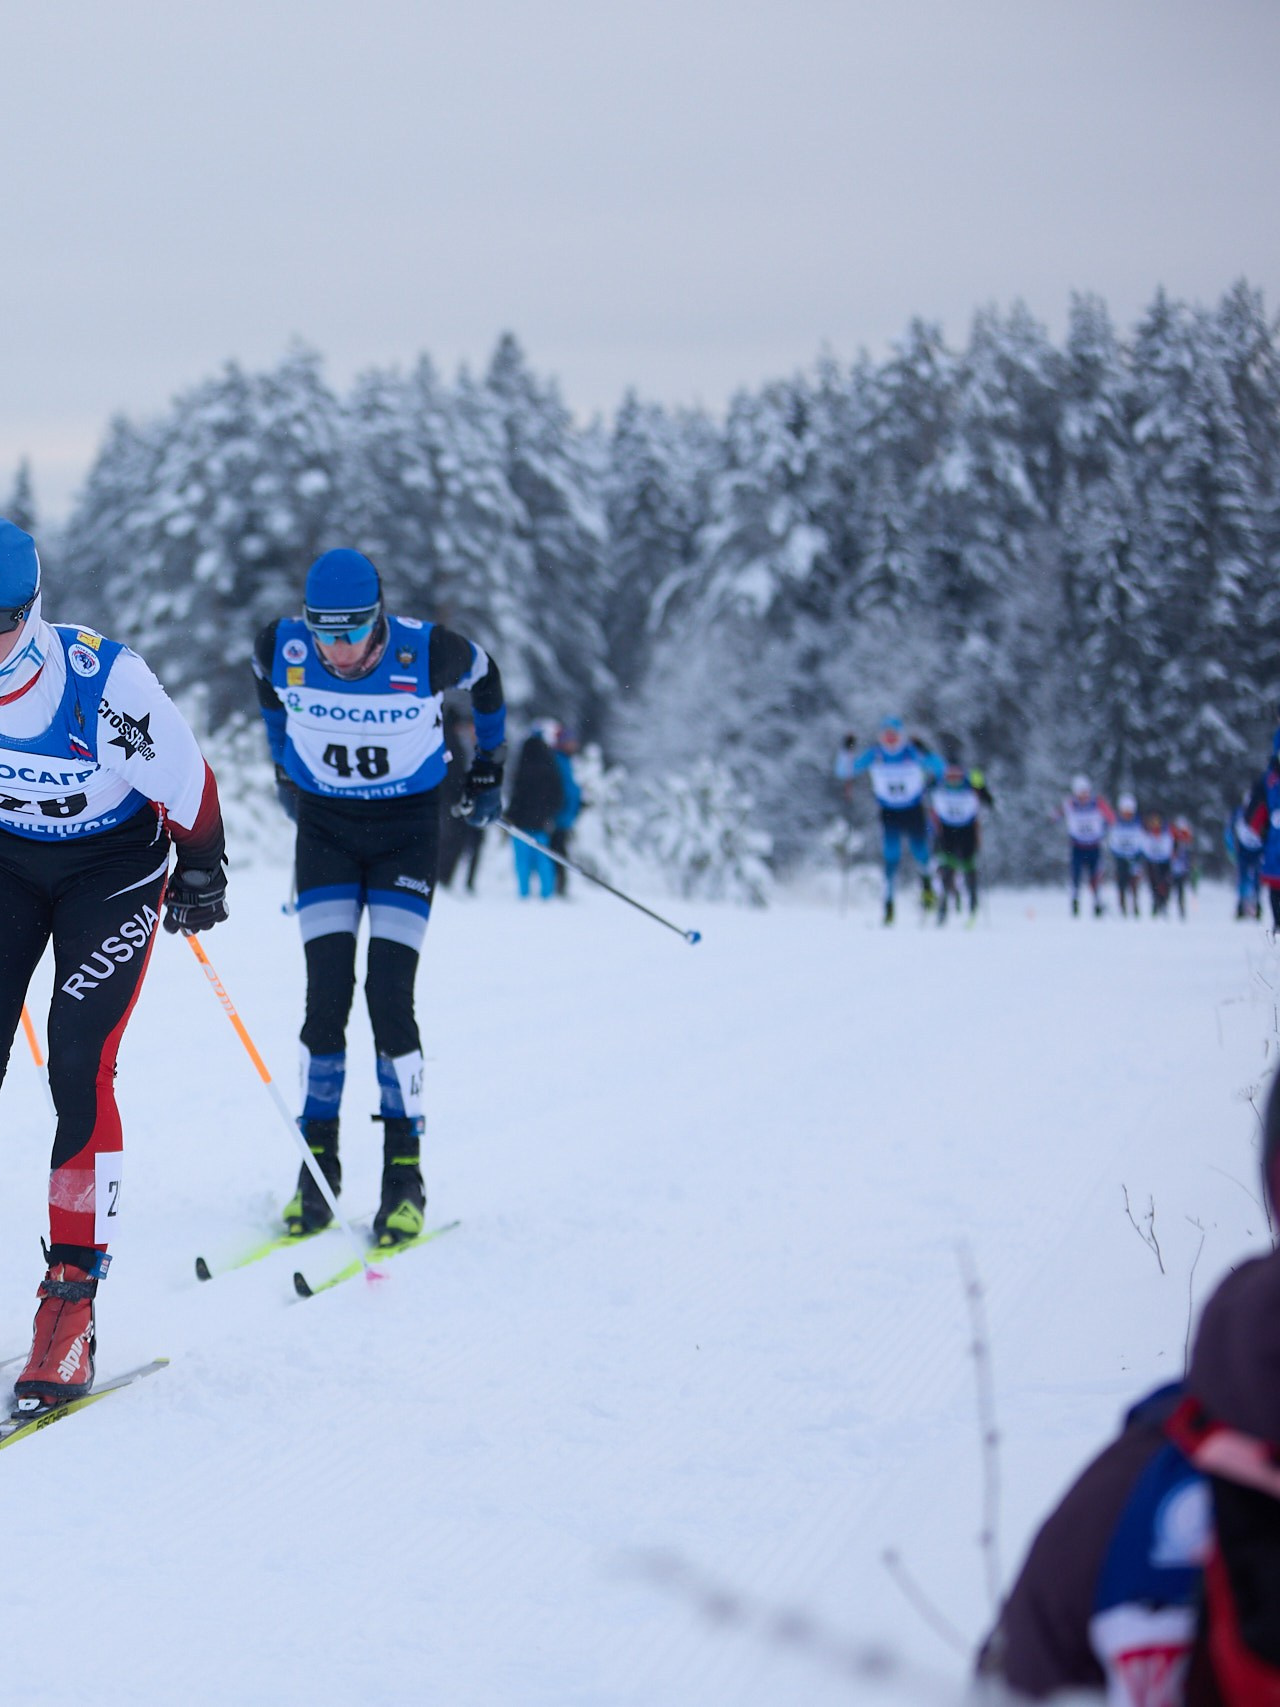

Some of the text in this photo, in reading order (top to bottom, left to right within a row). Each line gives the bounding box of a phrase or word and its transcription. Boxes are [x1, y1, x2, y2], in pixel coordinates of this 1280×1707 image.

[308, 704, 420, 723] ФОСАГРО
[322, 743, 390, 780] 48
[61, 904, 160, 1001] RUSSIA
